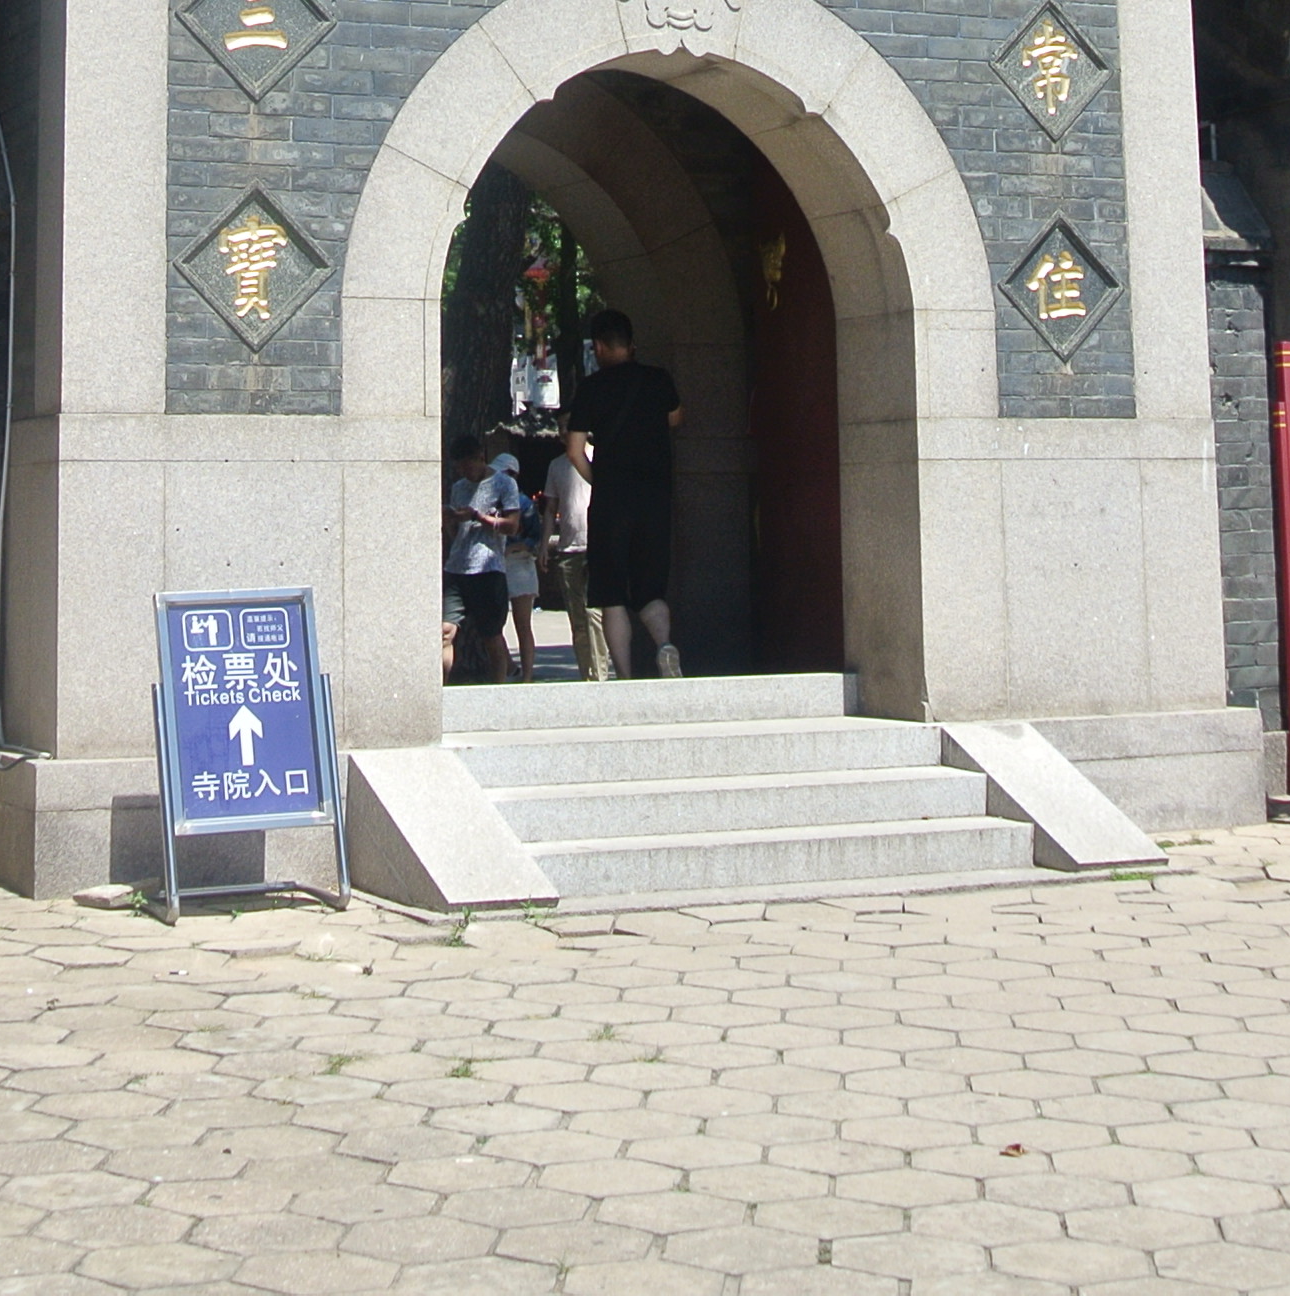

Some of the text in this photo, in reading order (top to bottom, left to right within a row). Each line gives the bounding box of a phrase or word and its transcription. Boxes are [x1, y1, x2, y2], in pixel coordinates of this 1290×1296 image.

[181, 651, 299, 690] 检票处
[184, 686, 301, 706] Tickets Check
[192, 769, 309, 801] 寺院入口
